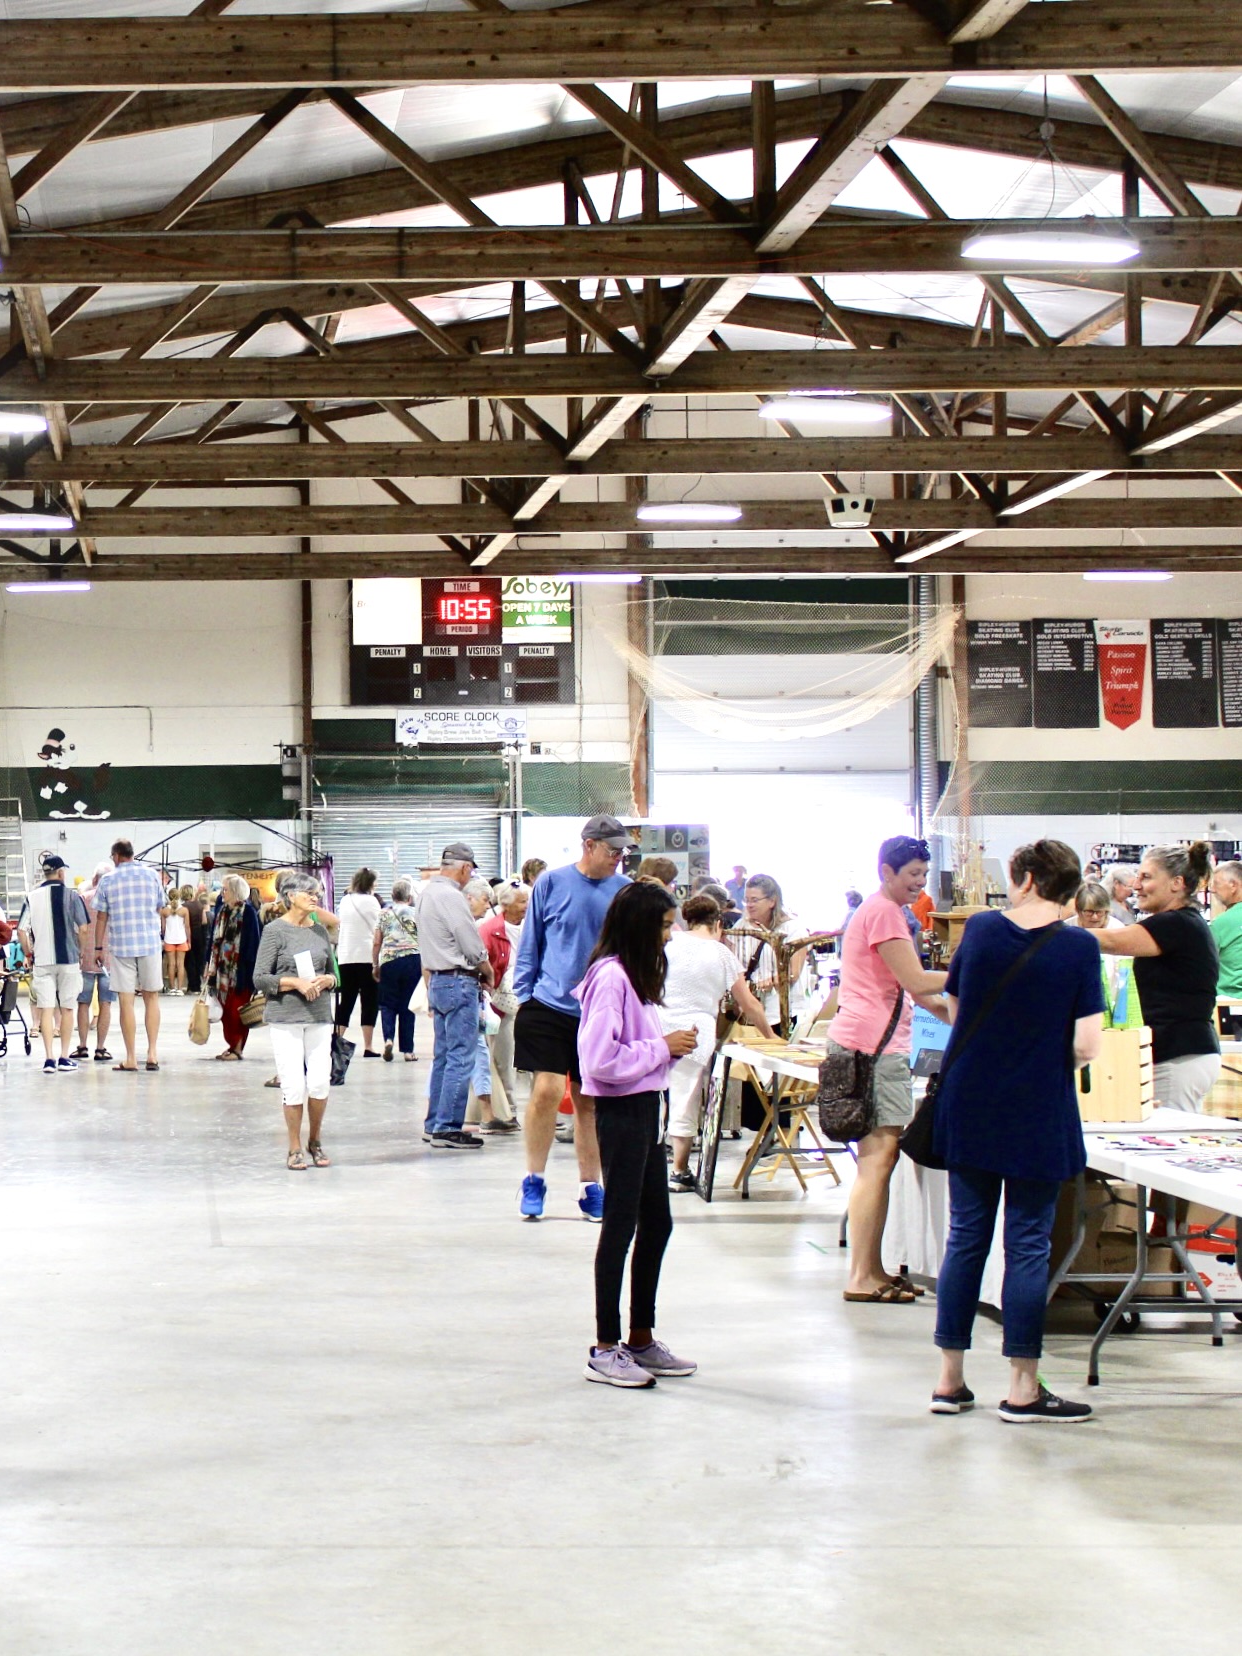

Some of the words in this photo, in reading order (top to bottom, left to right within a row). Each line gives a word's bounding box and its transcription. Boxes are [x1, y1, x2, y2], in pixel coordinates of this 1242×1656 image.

[453, 583, 471, 591] TIME
[501, 577, 571, 597] Sobeys
[440, 599, 491, 620] 10:55
[503, 603, 531, 612] OPEN
[533, 603, 539, 612] 7
[542, 603, 571, 612] DAYS
[516, 615, 523, 625] A
[525, 615, 557, 625] WEEK
[451, 625, 473, 633] PERIOD
[375, 648, 402, 656] PENALTY
[429, 647, 452, 656] HOME
[468, 646, 501, 655] VISITORS
[523, 647, 550, 655] PENALTY
[1111, 666, 1133, 675] Spirit
[1106, 681, 1138, 691] Triumph
[415, 689, 420, 698] 2
[506, 688, 511, 697] 2
[424, 712, 460, 721] SCORE
[464, 712, 500, 721] CLOCK
[399, 717, 414, 729] BREW
